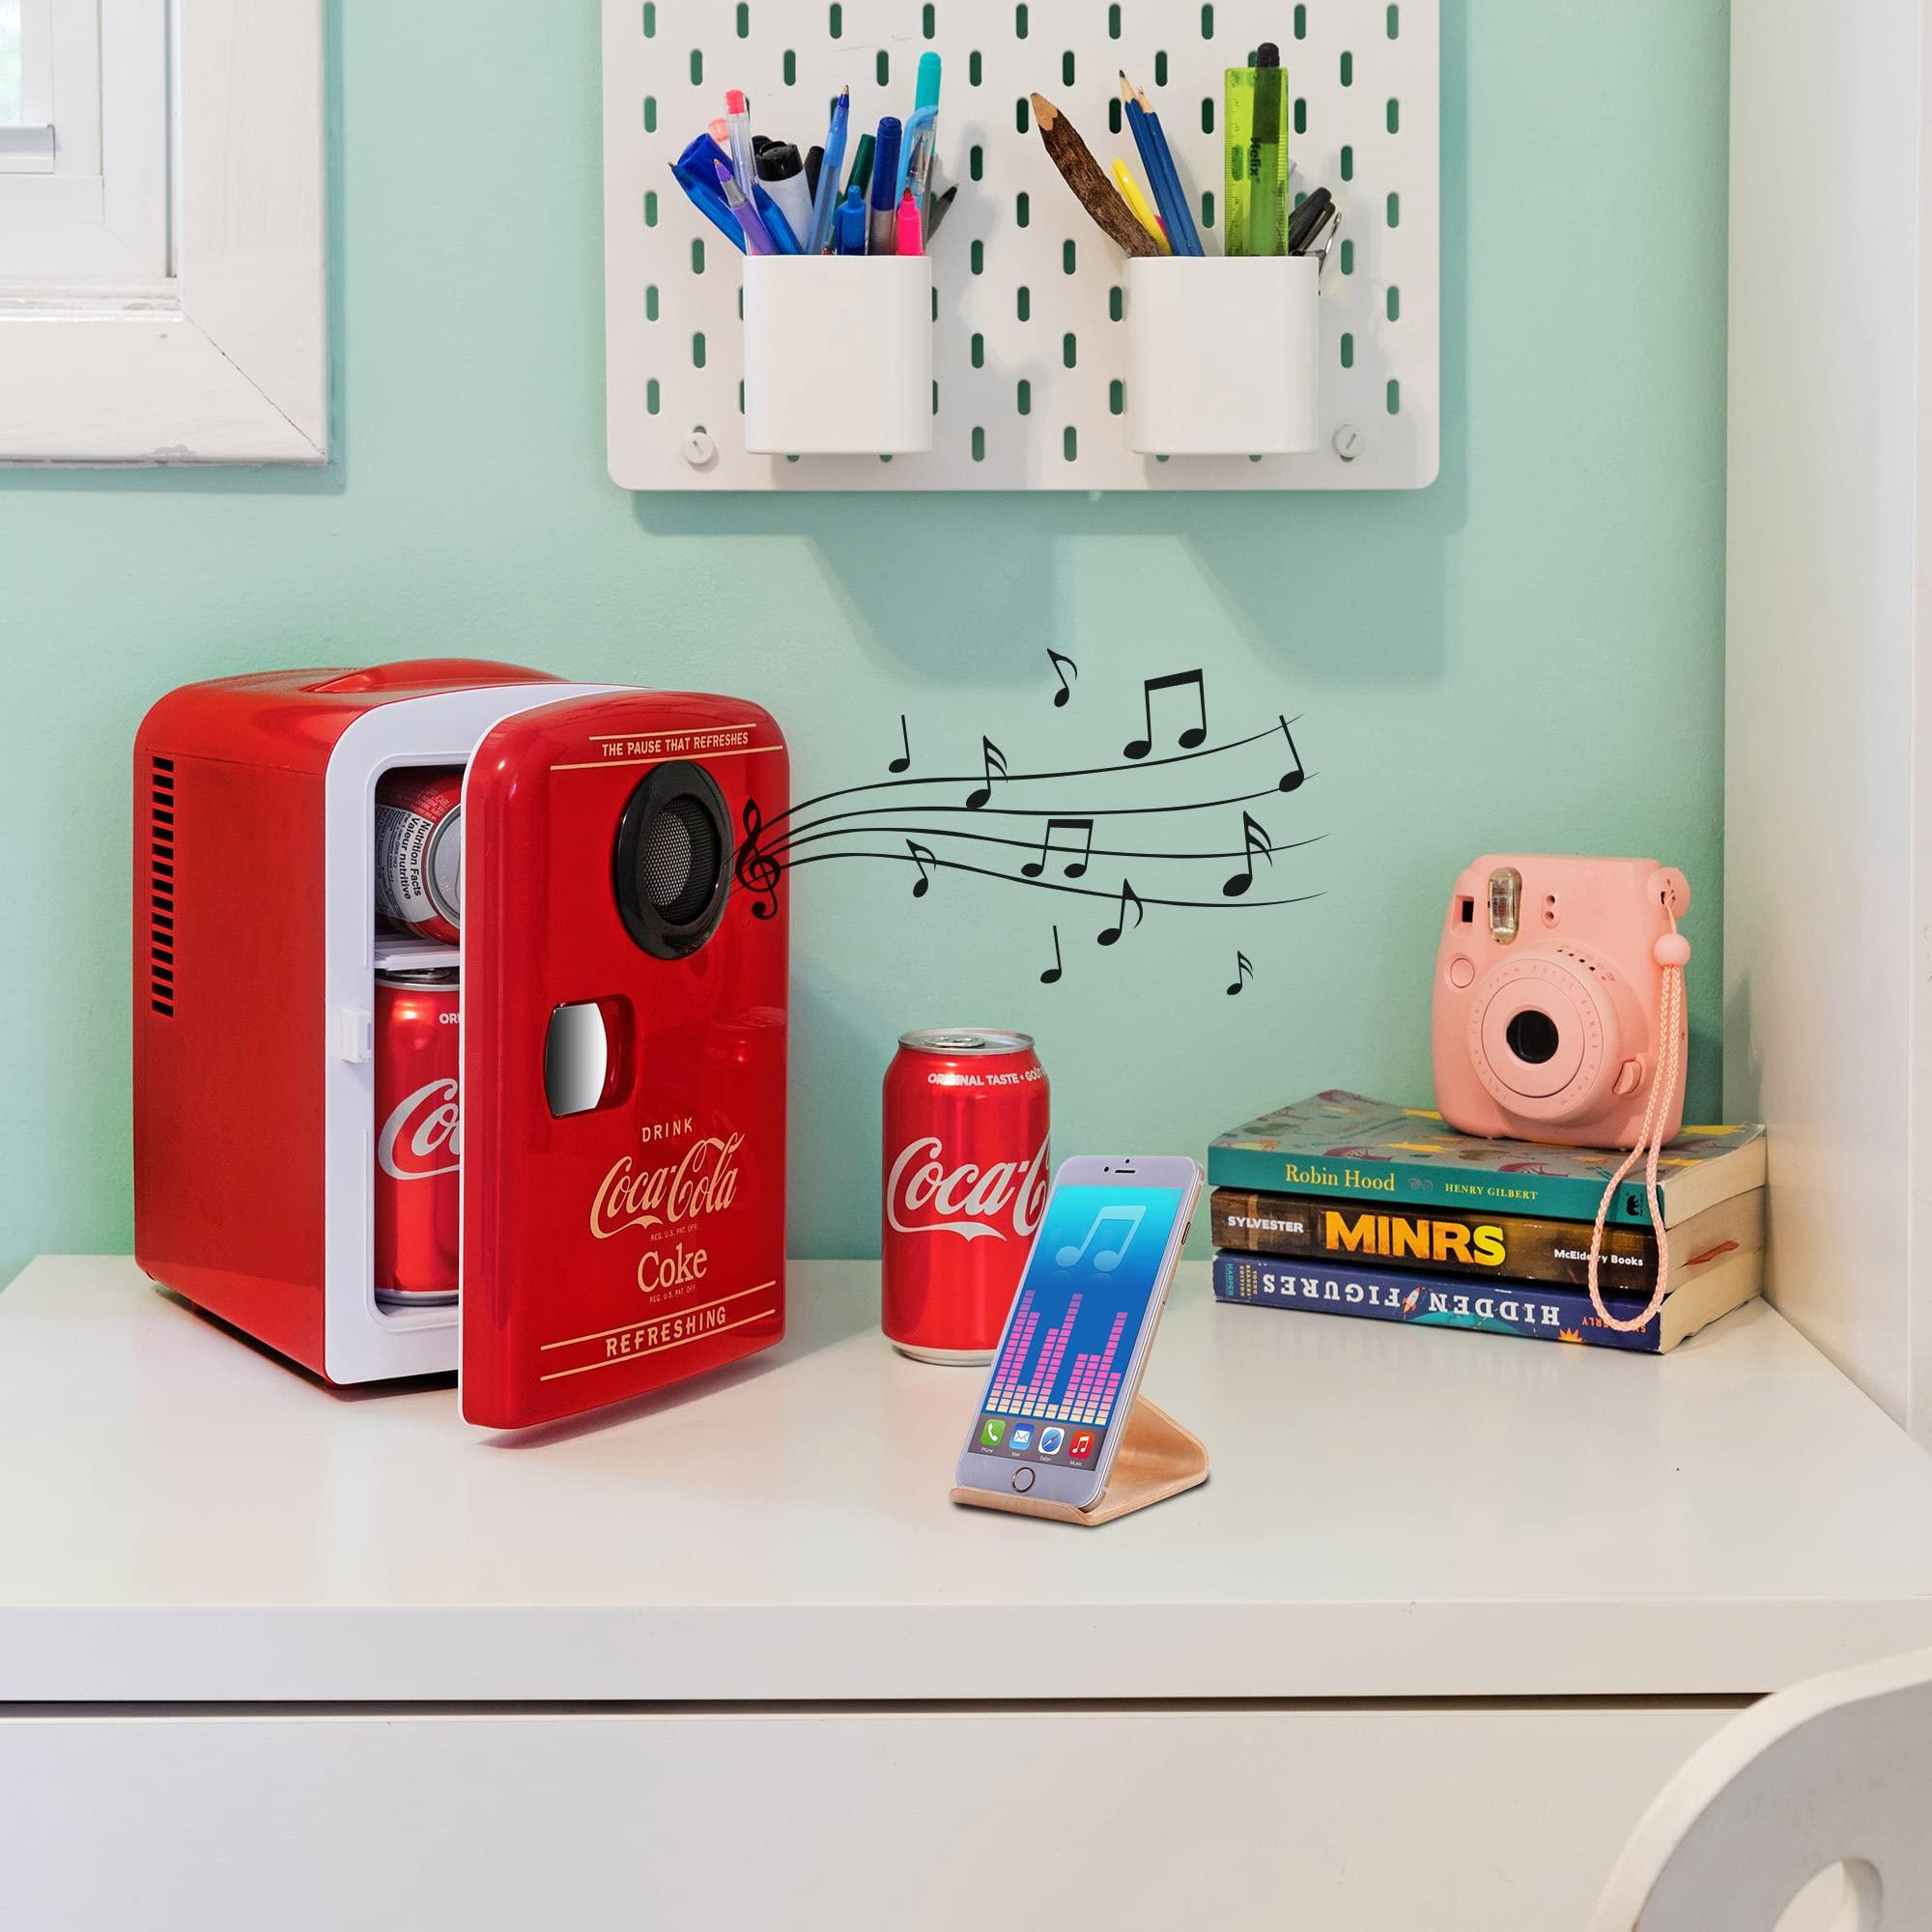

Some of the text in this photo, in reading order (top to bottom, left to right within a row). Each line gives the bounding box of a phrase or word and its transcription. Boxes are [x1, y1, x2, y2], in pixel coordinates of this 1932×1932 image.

[602, 731, 749, 757] THE PAUSE THAT REFRESHES
[399, 817, 420, 900] Valeur nutritive
[410, 820, 432, 896] Nutrition Facts
[927, 1072, 984, 1086] ORIGINAL
[985, 1072, 1019, 1086] TASTE
[641, 1117, 693, 1143] DRINK
[589, 1132, 745, 1239] Coca-Cola
[1285, 1163, 1396, 1191] Robin Hood
[1445, 1183, 1539, 1201] HENRY GILBERT
[1228, 1215, 1304, 1234] SYLVESTER
[1324, 1210, 1506, 1266] MINRS
[637, 1243, 708, 1293] Coke
[1610, 1254, 1644, 1266] Books
[1262, 1272, 1561, 1326] HIDDEN FIGURES
[605, 1306, 726, 1357] REFRESHING
